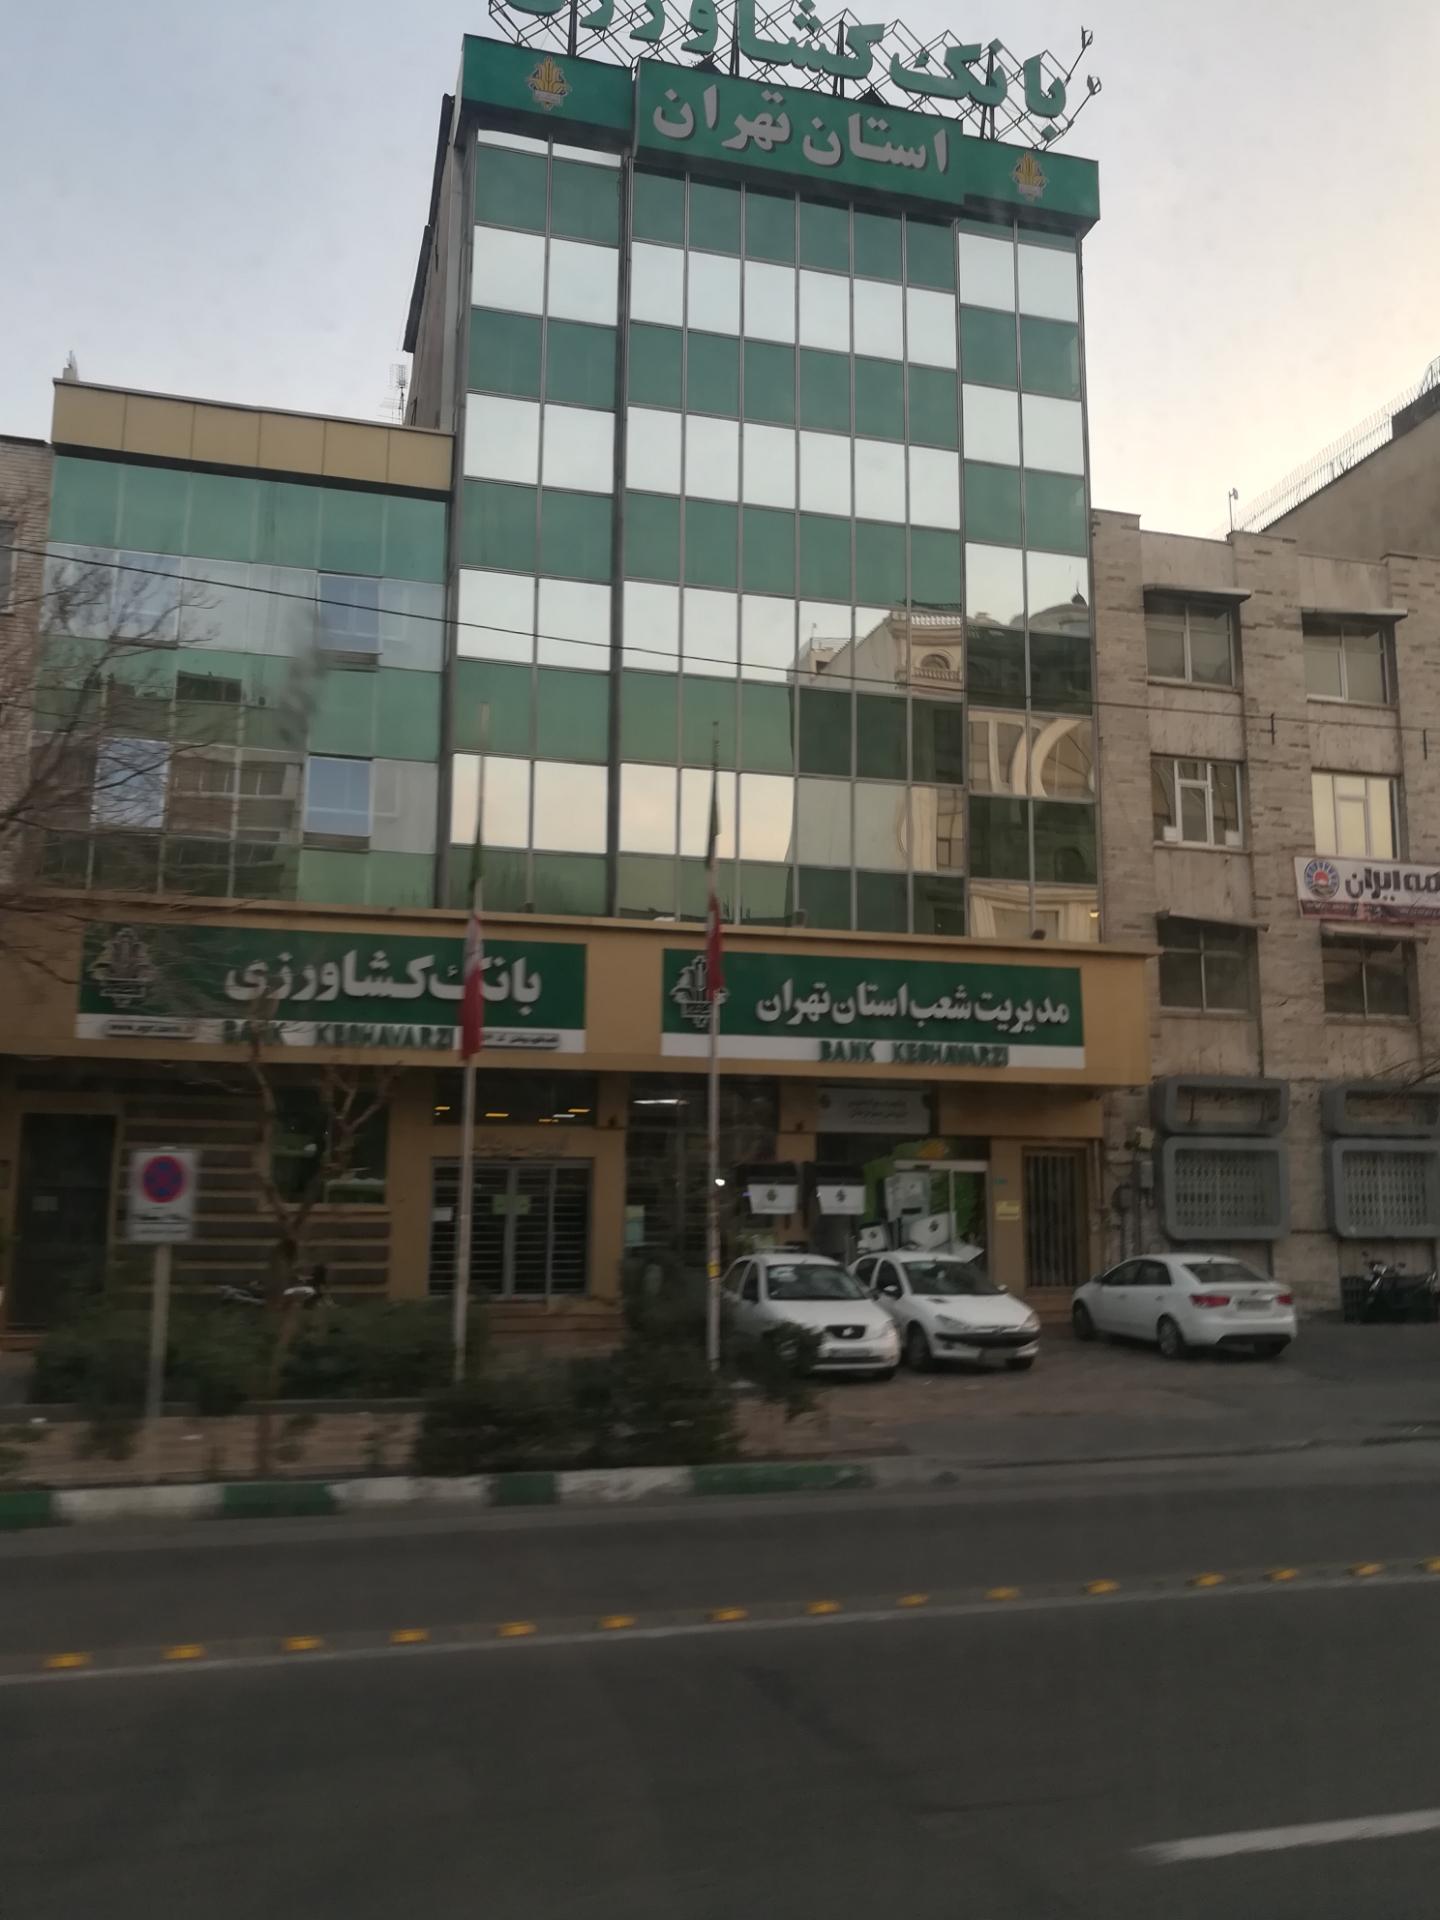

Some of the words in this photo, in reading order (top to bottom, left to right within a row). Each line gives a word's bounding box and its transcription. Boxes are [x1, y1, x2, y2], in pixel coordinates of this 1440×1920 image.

[504, 0, 885, 80] کشاور
[889, 38, 1067, 141] بانک
[652, 85, 792, 152] تهران
[803, 113, 948, 174] استان
[1345, 867, 1400, 901] ایران
[224, 950, 436, 1002] کشاورزی
[755, 979, 831, 1025] تهران
[831, 982, 910, 1025] استان
[911, 984, 972, 1028] شعب
[974, 986, 1070, 1034] مدیریت
[223, 1020, 285, 1045] BAK
[817, 1040, 875, 1062] BANK
